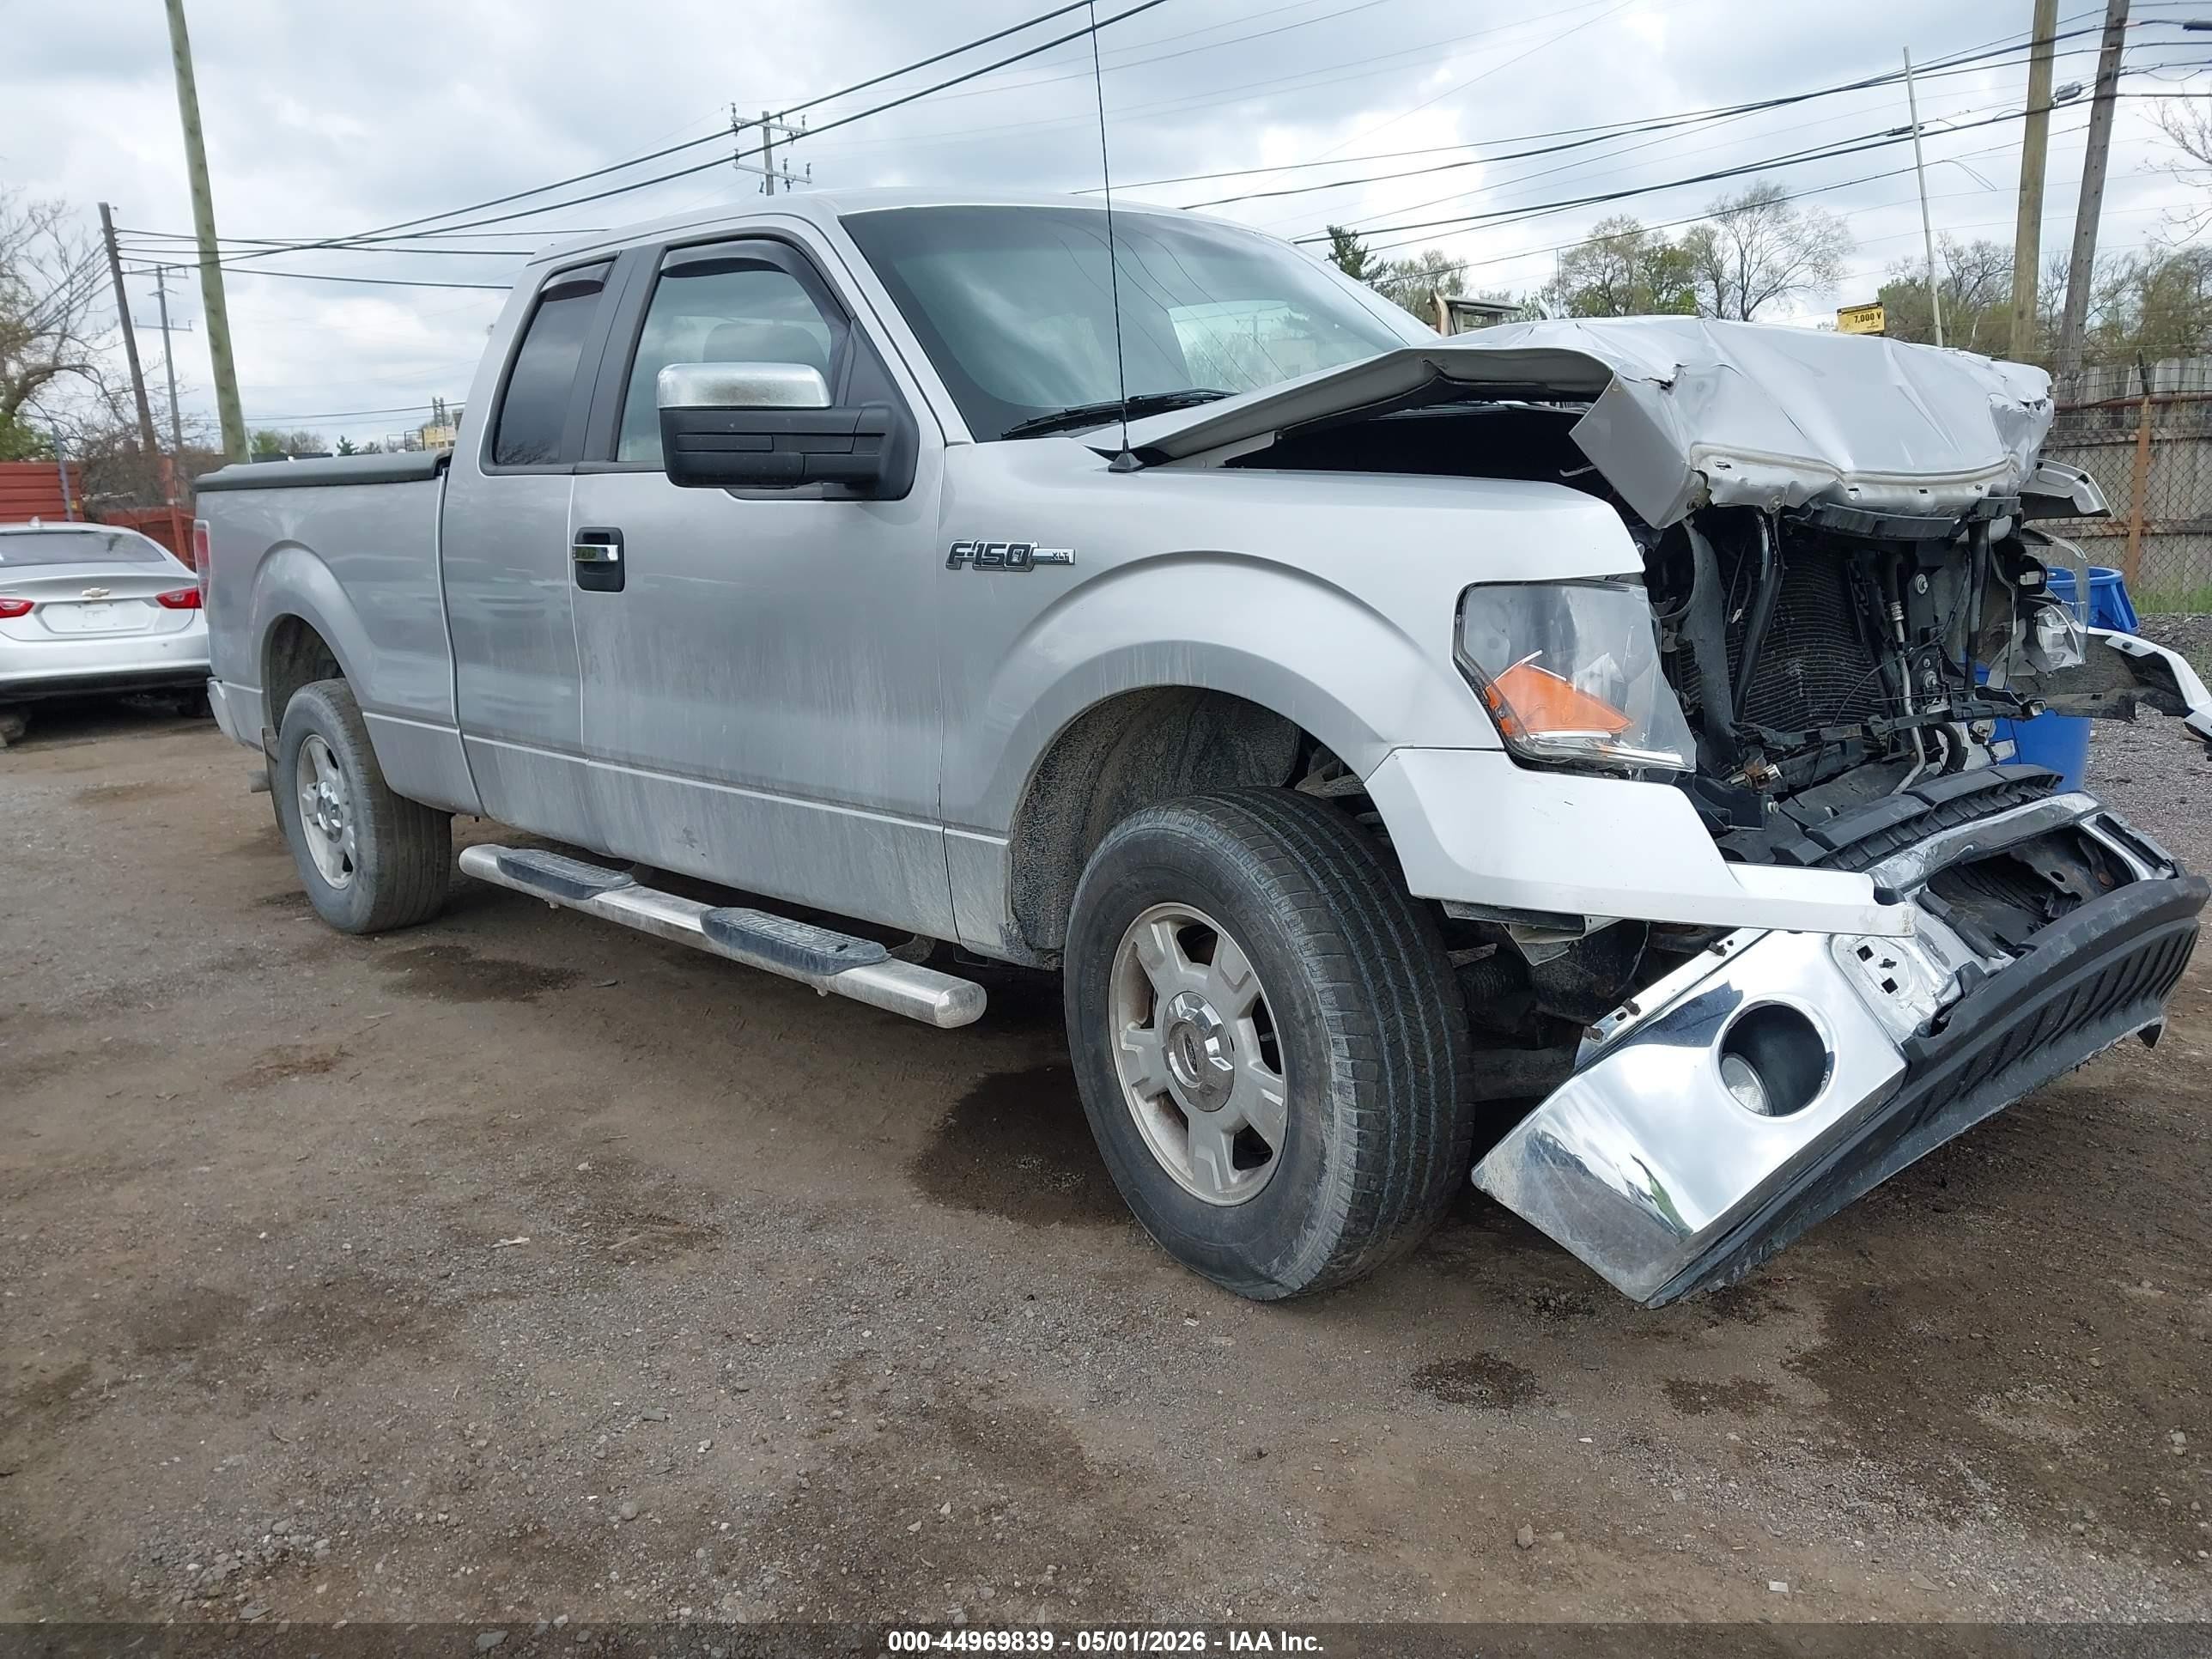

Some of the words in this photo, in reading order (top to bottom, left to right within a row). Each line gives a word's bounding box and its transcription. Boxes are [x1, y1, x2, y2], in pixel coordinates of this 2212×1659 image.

[1854, 313, 1875, 323] 7,000
[946, 540, 1036, 571] F-150
[1050, 551, 1070, 562] XLT
